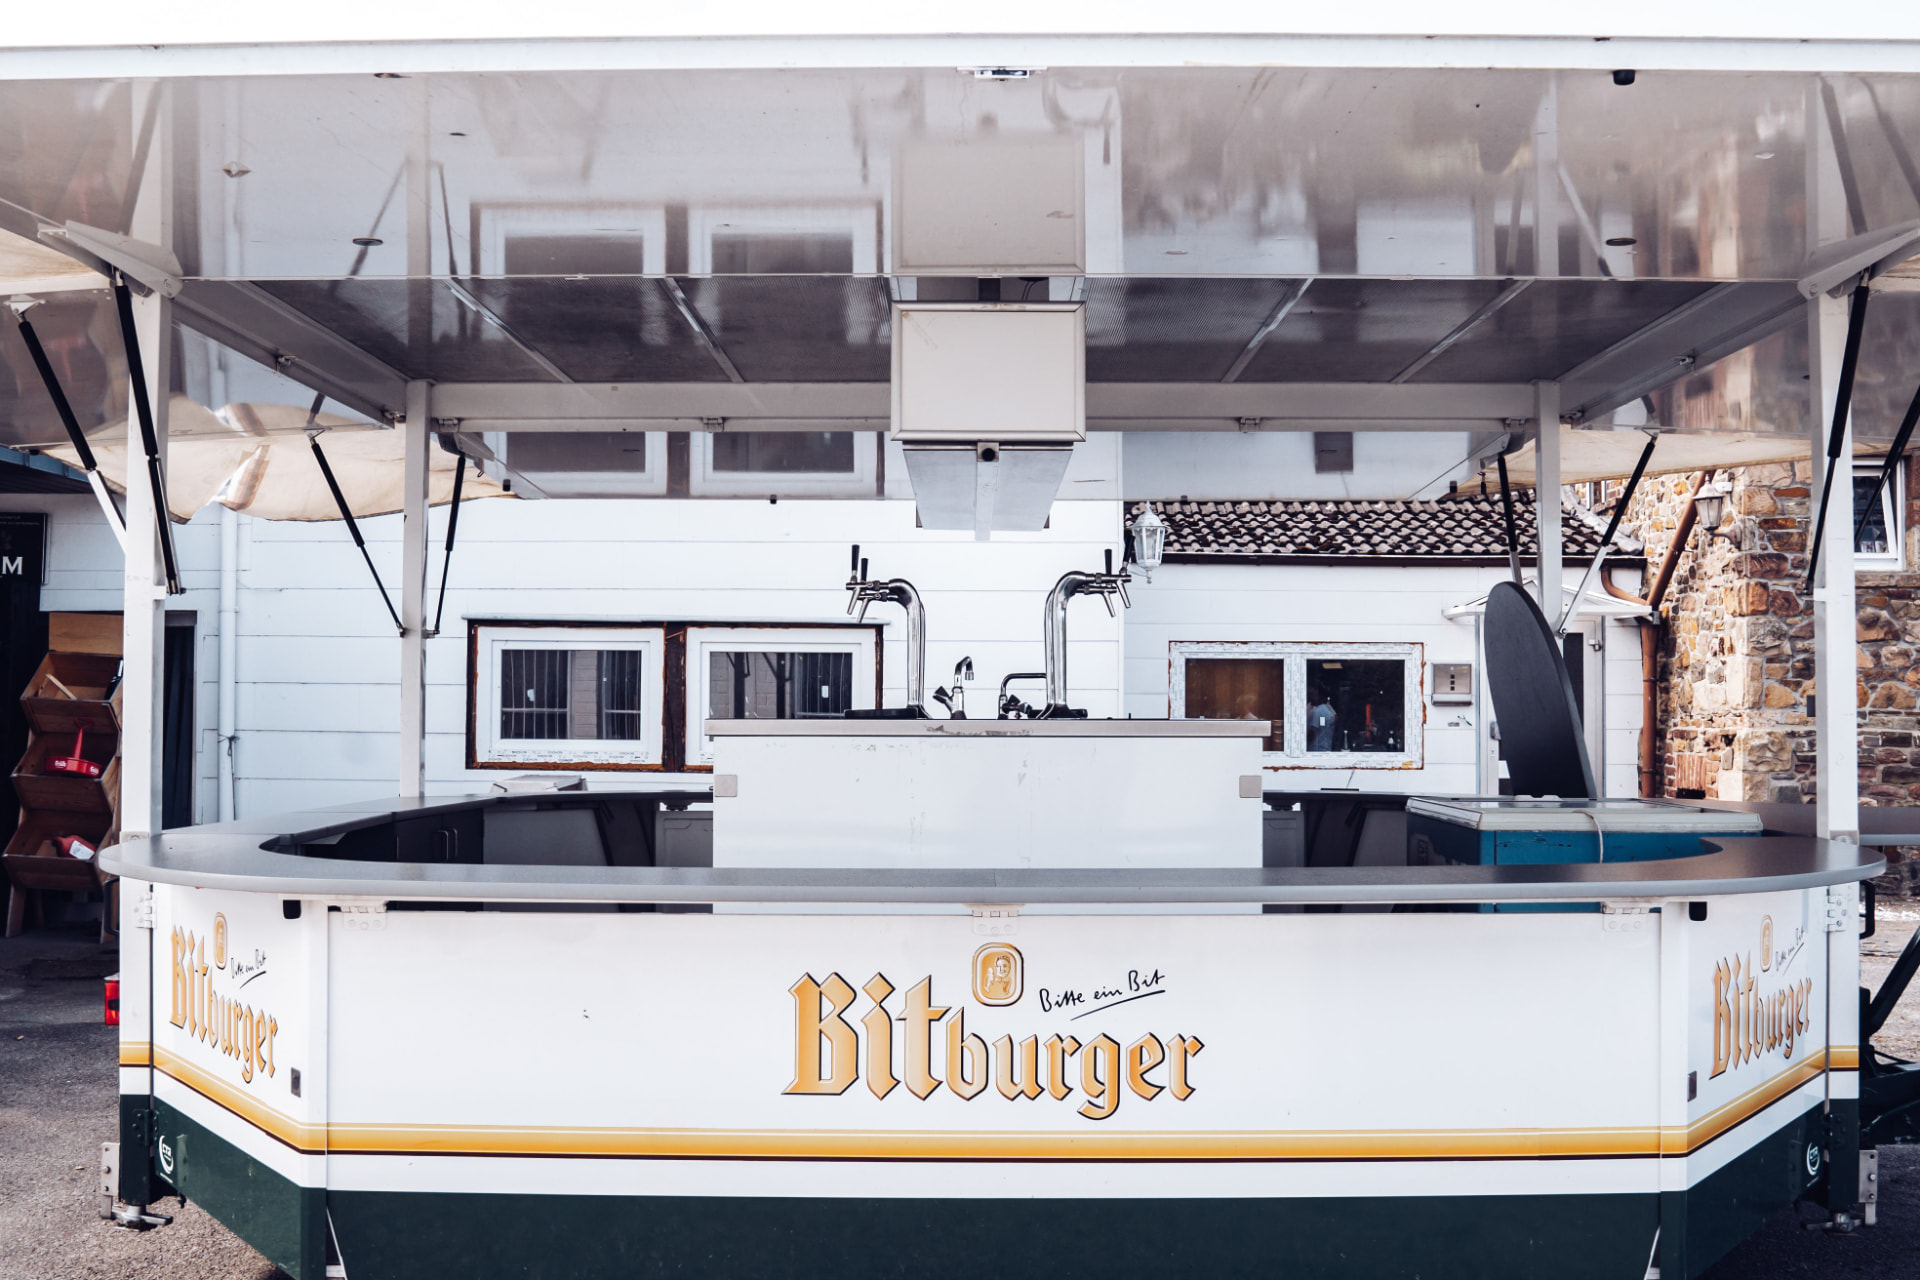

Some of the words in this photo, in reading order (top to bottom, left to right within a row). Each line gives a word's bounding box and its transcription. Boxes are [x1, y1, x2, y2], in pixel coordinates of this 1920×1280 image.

[169, 923, 279, 1084] Bitburger
[780, 971, 1206, 1121] Bitburger
[1039, 988, 1086, 1013] Bitte
[1093, 986, 1123, 1000] ein
[1128, 969, 1166, 992] Bit
[1708, 948, 1813, 1081] Bitburger
